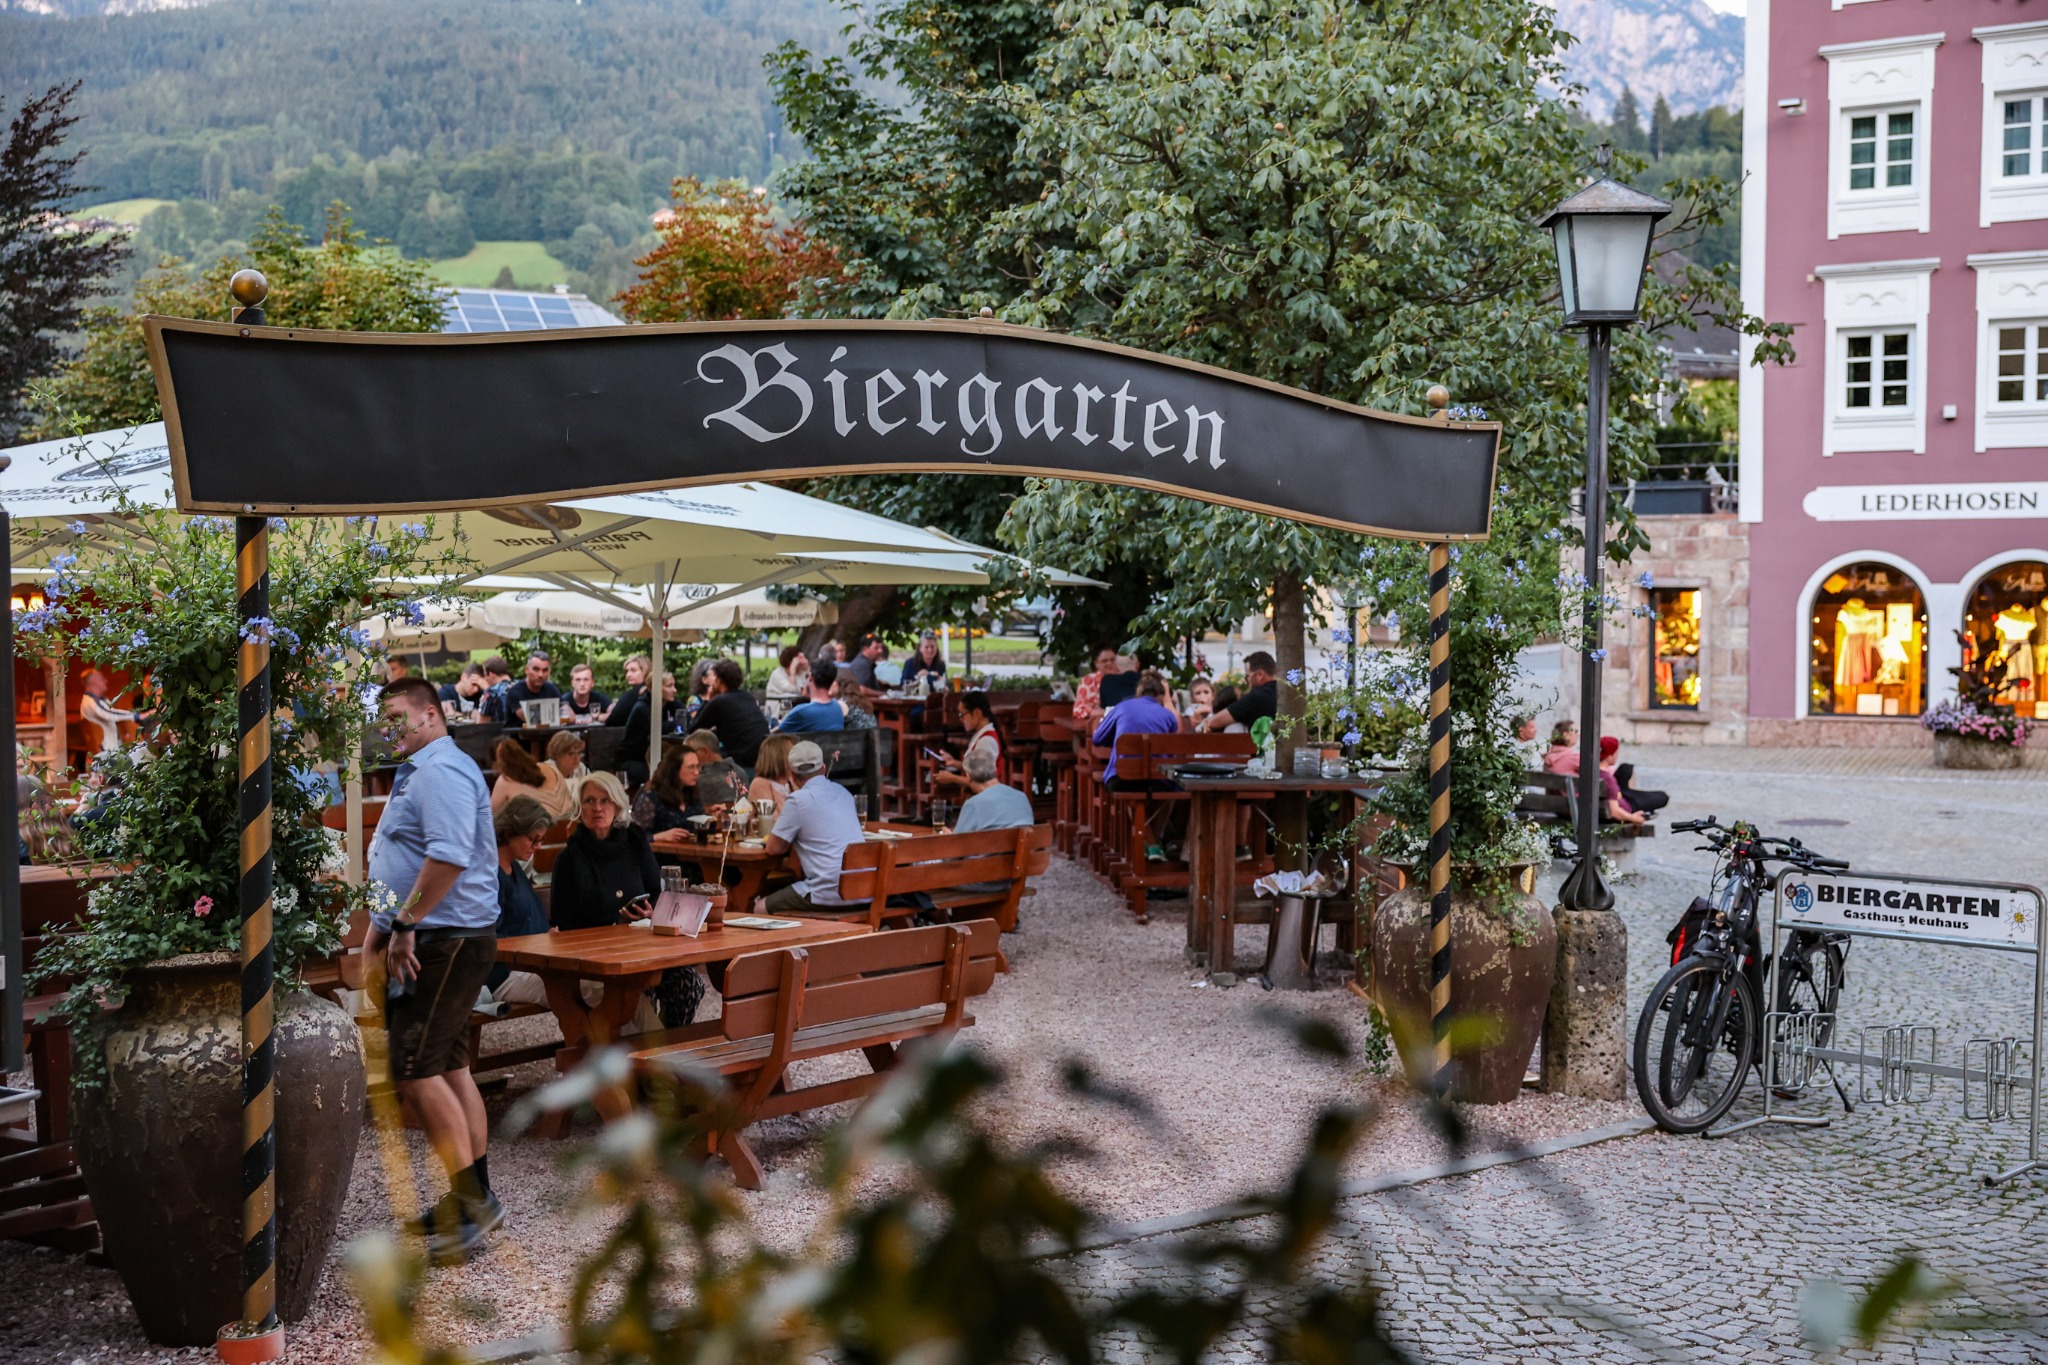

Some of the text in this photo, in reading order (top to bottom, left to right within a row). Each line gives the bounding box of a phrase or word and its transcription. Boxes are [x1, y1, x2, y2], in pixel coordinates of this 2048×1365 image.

[696, 341, 1227, 470] Biergarten
[1860, 491, 2038, 512] LEDERHOSEN
[1816, 884, 2000, 918] BIERGARTEN
[1843, 909, 1969, 930] Gasthaus Neuhaus
